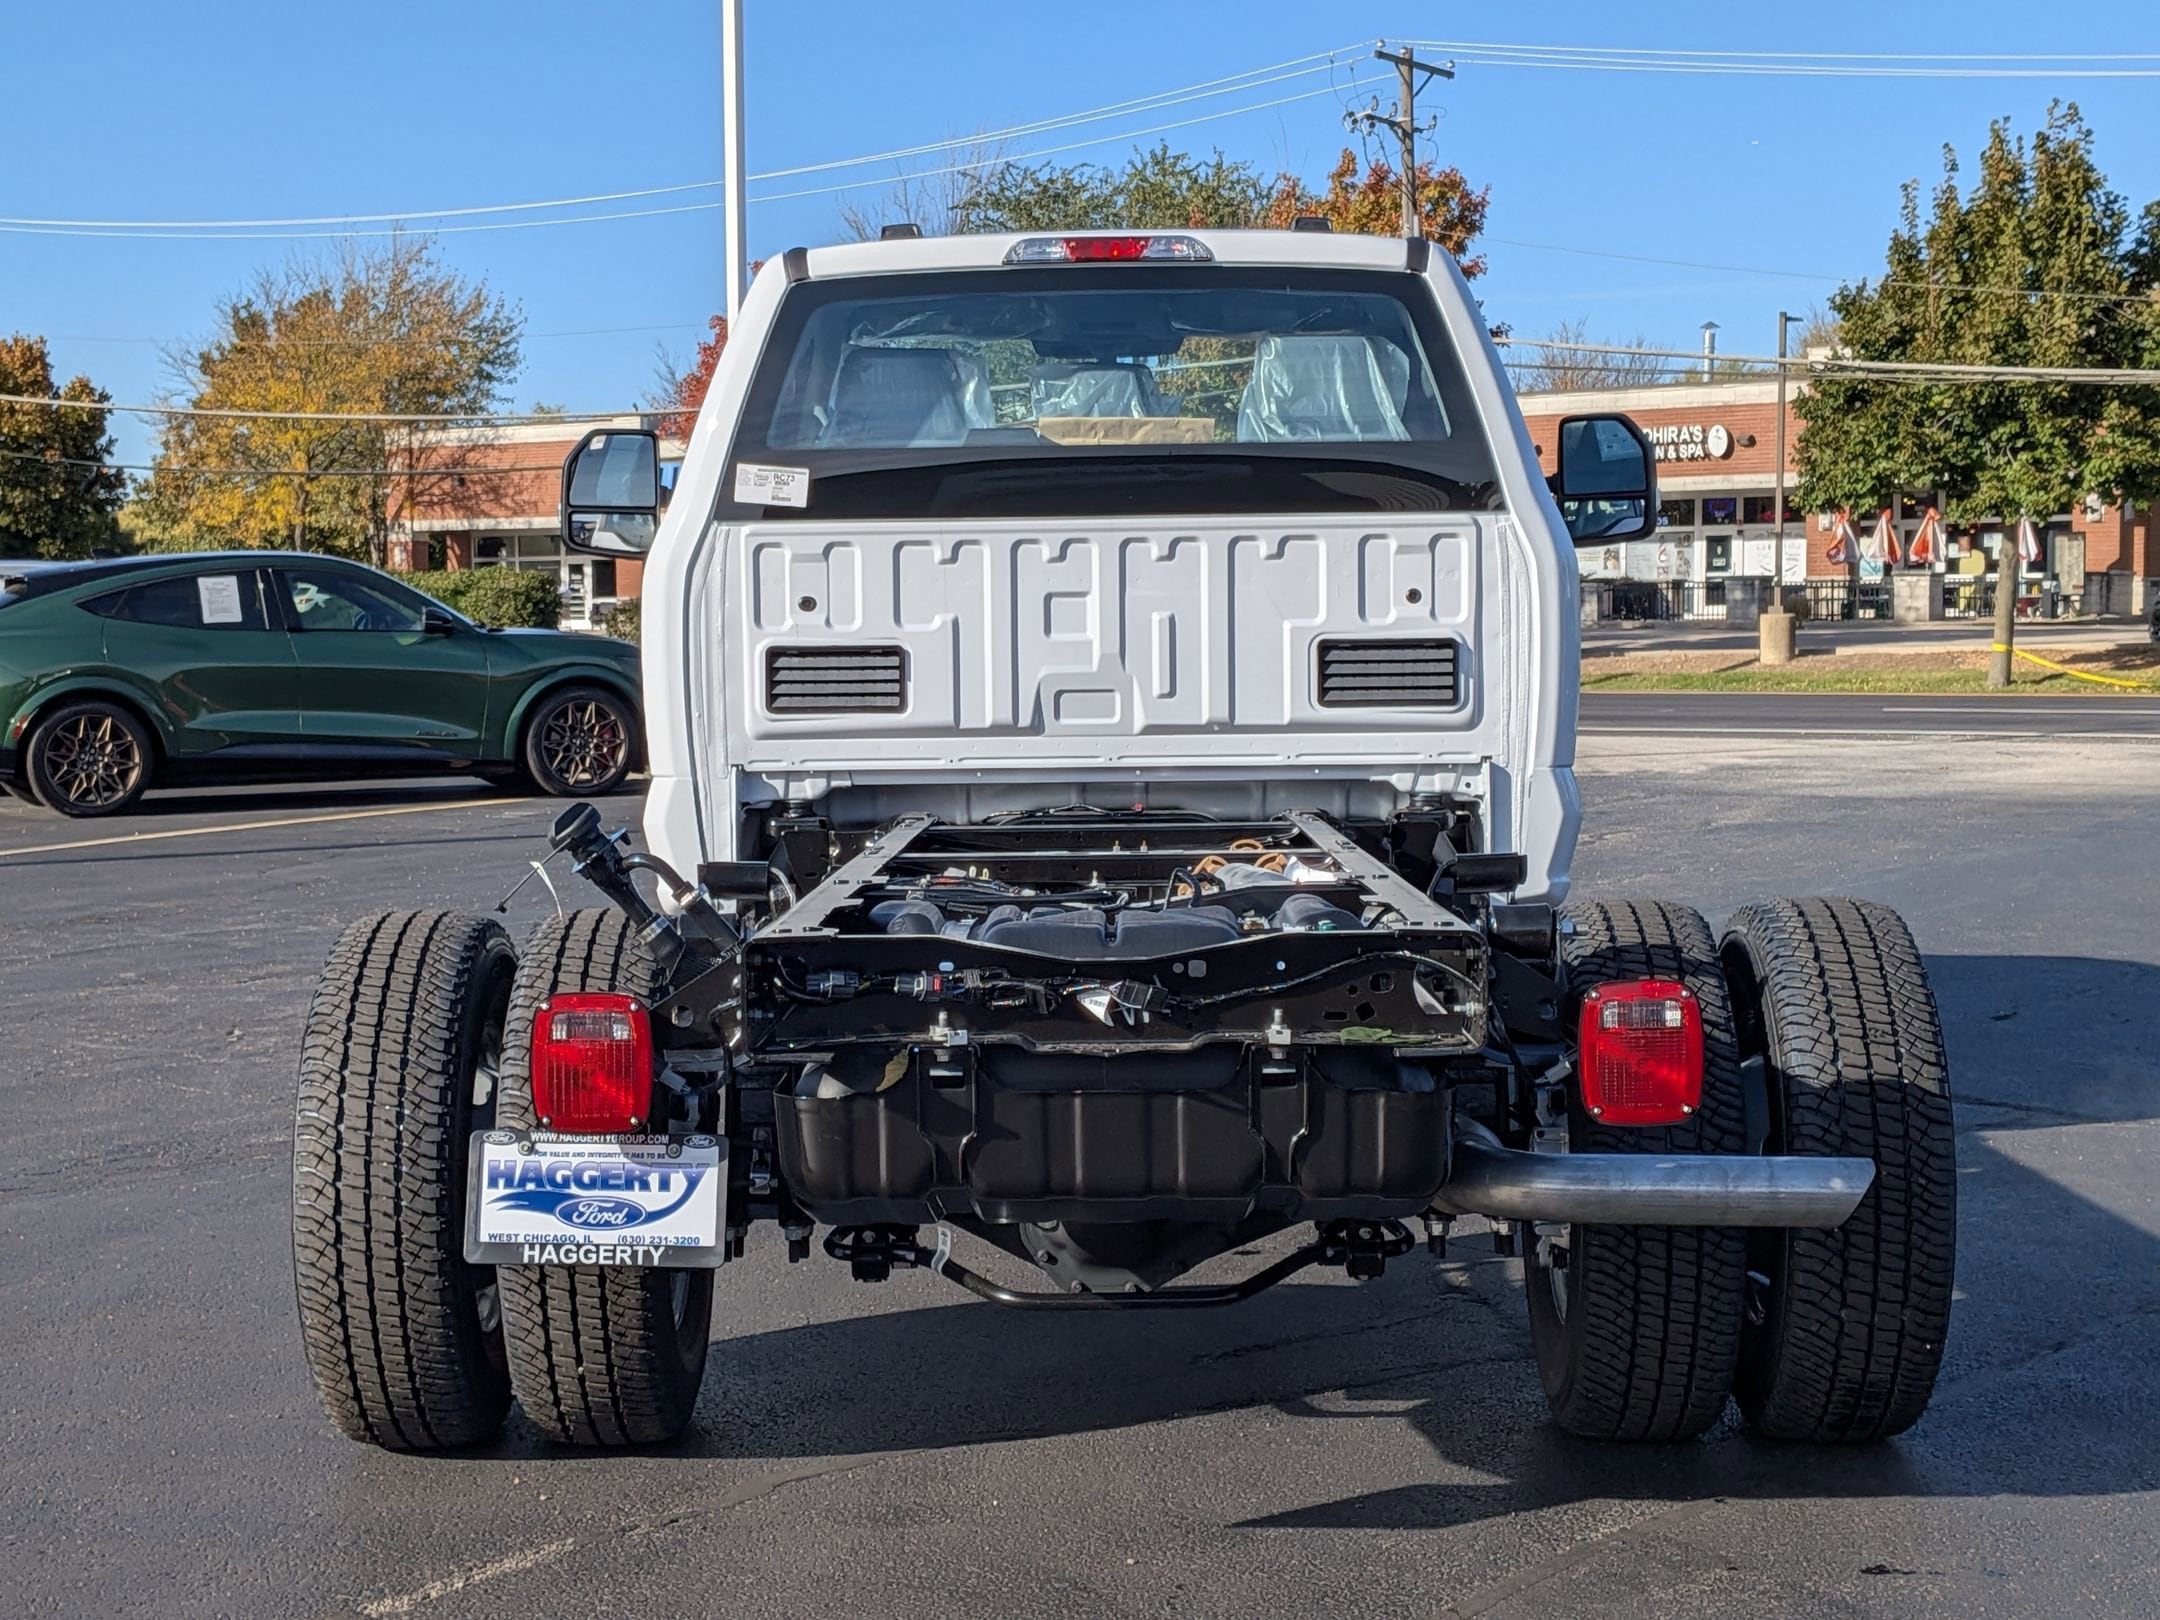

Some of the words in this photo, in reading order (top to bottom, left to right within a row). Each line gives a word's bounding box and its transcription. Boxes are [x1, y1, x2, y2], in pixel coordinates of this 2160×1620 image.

[1667, 445, 1677, 459] &
[1679, 443, 1705, 459] SPA
[487, 1130, 512, 1144] Ford
[530, 1132, 669, 1145] WWW.HAGGERTYGROUP.COM
[687, 1135, 712, 1147] Ford
[587, 1151, 622, 1159] INTEGRITY
[646, 1152, 656, 1160] TO
[486, 1160, 711, 1192] HAGGERTY
[572, 1201, 628, 1226] Ford
[487, 1232, 521, 1243] WEST
[523, 1233, 580, 1244] CHICAGO,
[583, 1234, 594, 1244] IL
[617, 1234, 646, 1246] (630)
[649, 1235, 701, 1246] 231-3200
[522, 1243, 667, 1266] HAGGERTY
